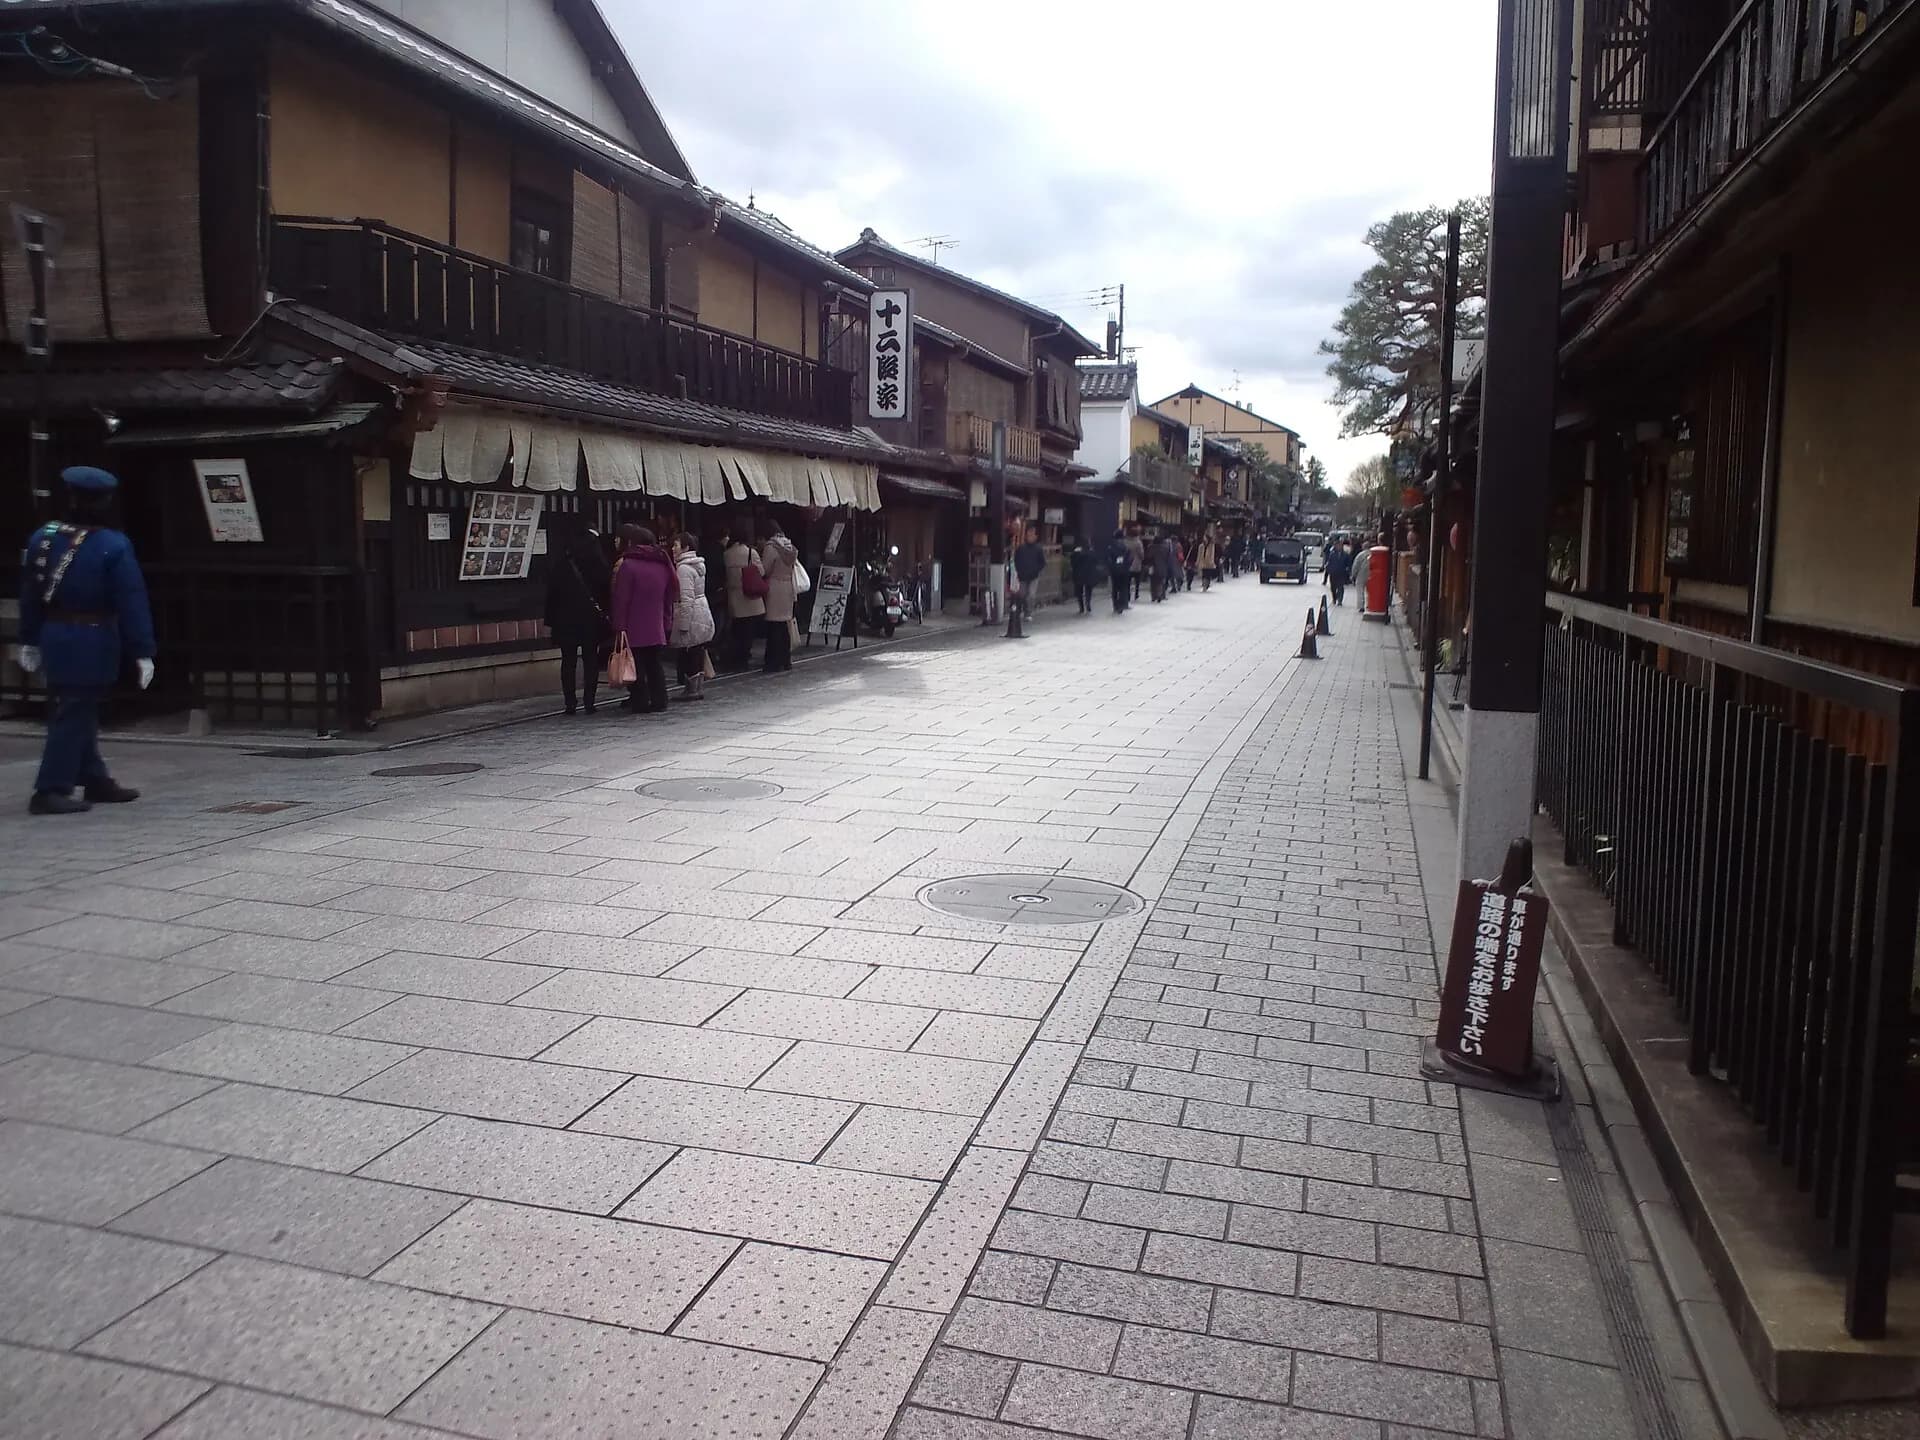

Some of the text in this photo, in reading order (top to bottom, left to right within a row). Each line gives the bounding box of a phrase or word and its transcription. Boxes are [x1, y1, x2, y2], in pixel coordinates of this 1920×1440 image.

[876, 299, 902, 411] 十二段家
[1459, 892, 1507, 1056] 道路の端をお歩き下さい
[1501, 898, 1528, 991] 車が通ります
